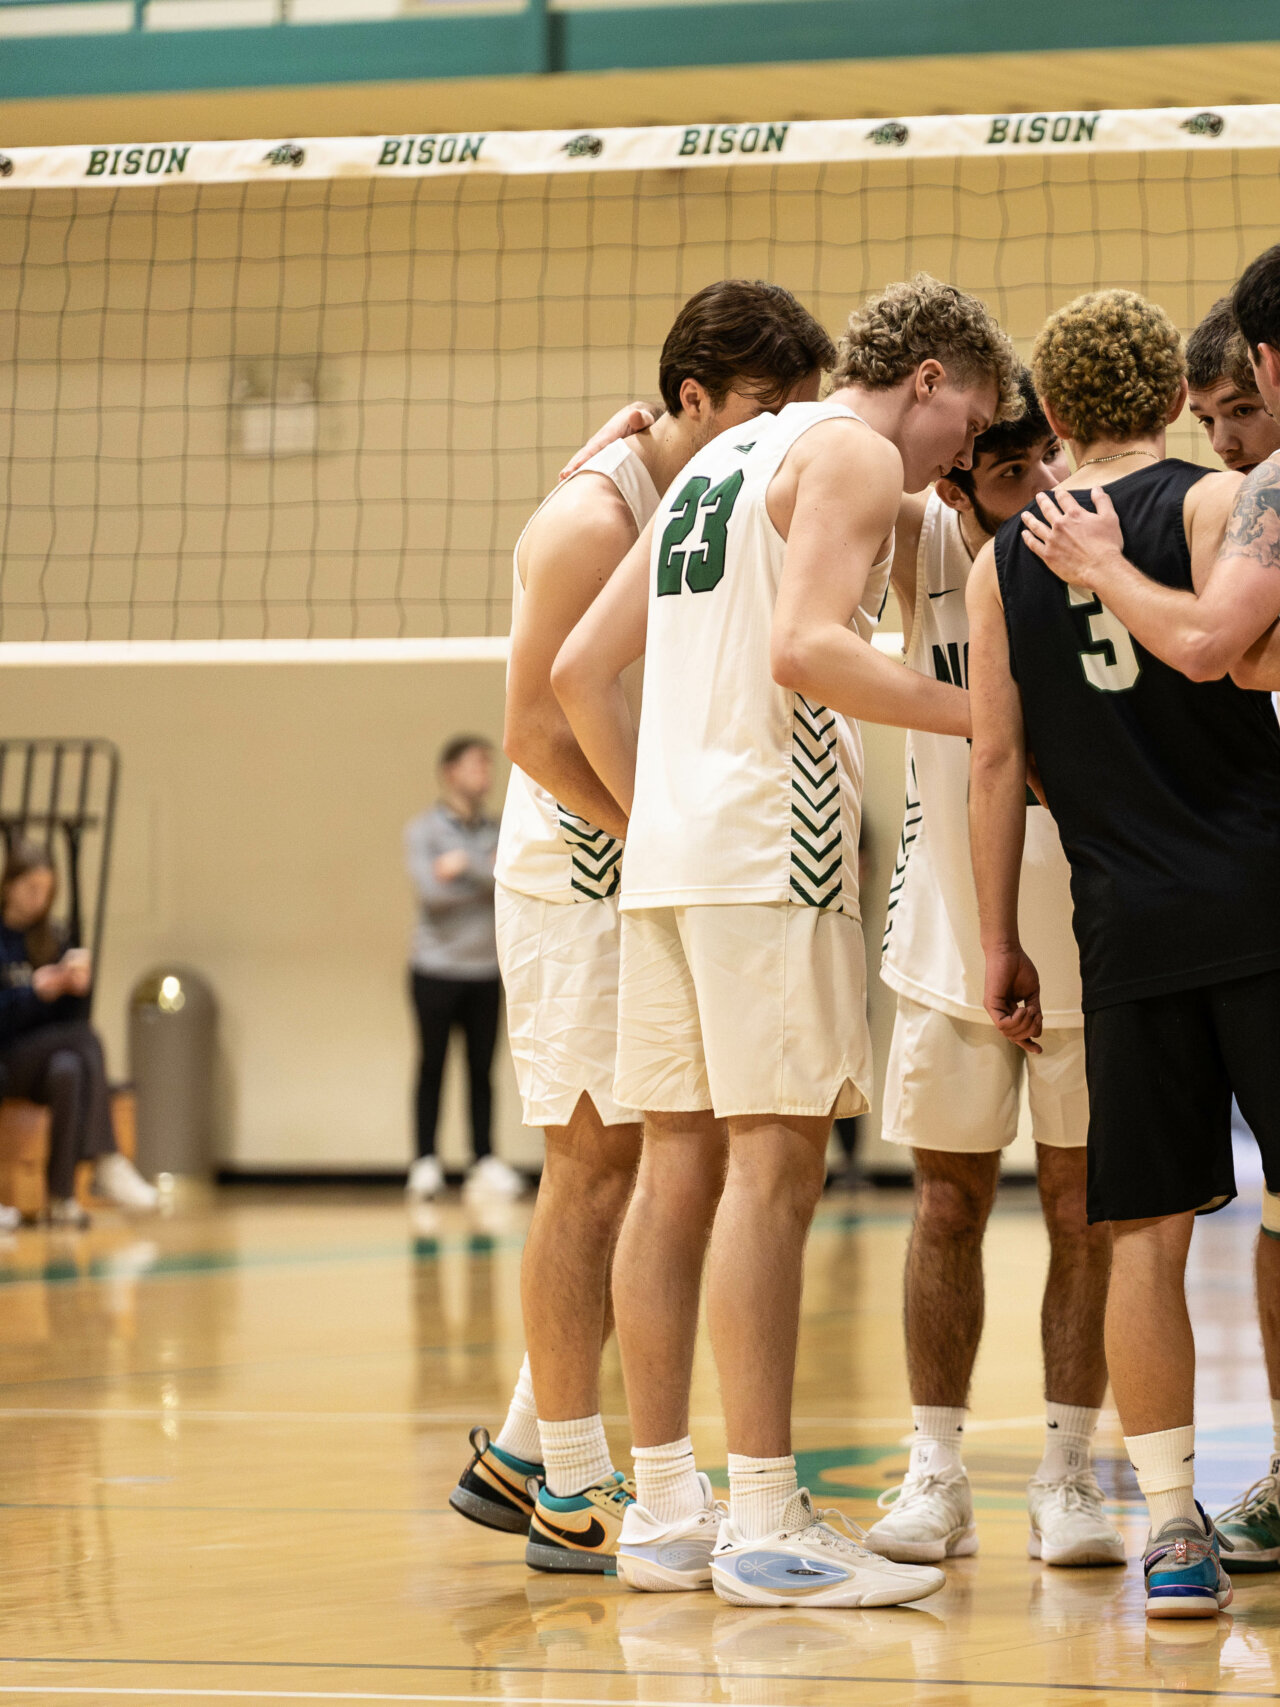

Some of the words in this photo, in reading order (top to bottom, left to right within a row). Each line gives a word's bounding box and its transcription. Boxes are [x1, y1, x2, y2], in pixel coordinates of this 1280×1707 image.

[679, 126, 788, 155] BISON
[988, 115, 1101, 145] BISON
[85, 148, 189, 175] BISON
[377, 137, 485, 165] BISON
[656, 468, 744, 596] 23
[1066, 582, 1143, 694] 3
